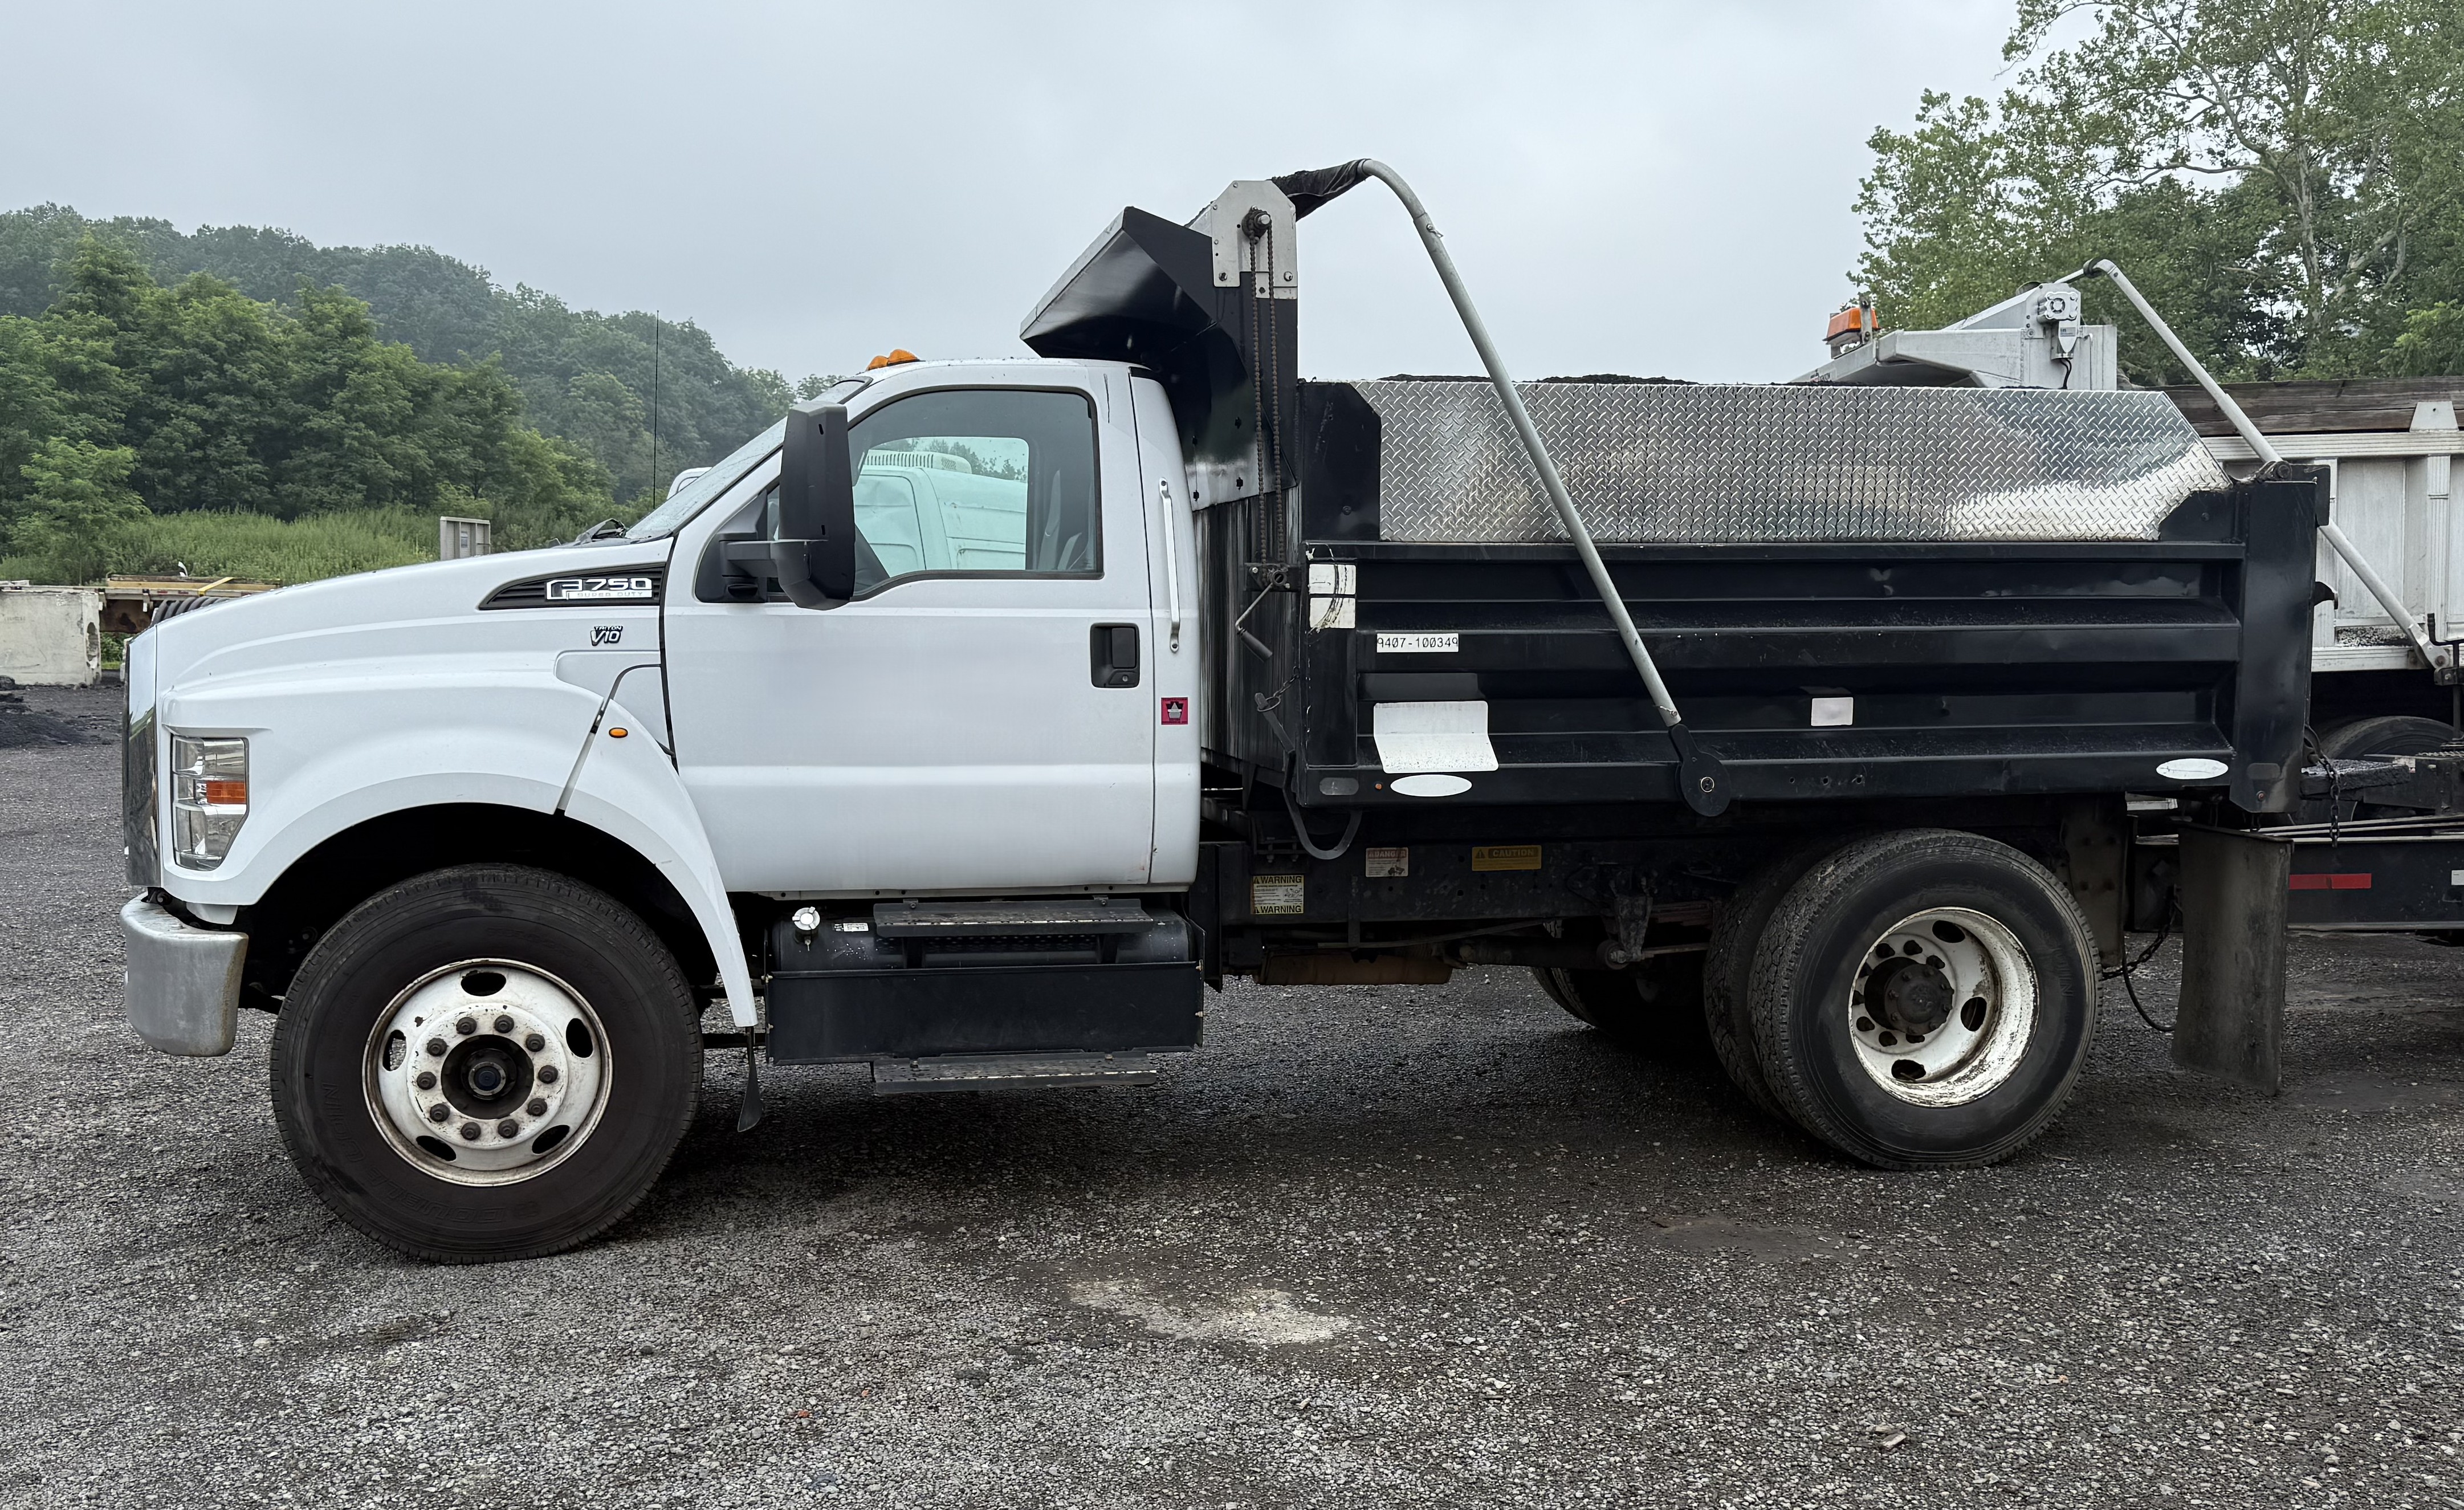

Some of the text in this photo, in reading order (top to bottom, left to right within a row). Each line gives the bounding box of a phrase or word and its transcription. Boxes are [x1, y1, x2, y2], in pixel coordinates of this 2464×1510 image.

[590, 630, 621, 645] V10
[1377, 637, 1458, 648] 9407-100349
[1493, 849, 1534, 857] CAUTION
[321, 1082, 507, 1223] DOUBLE COIN
